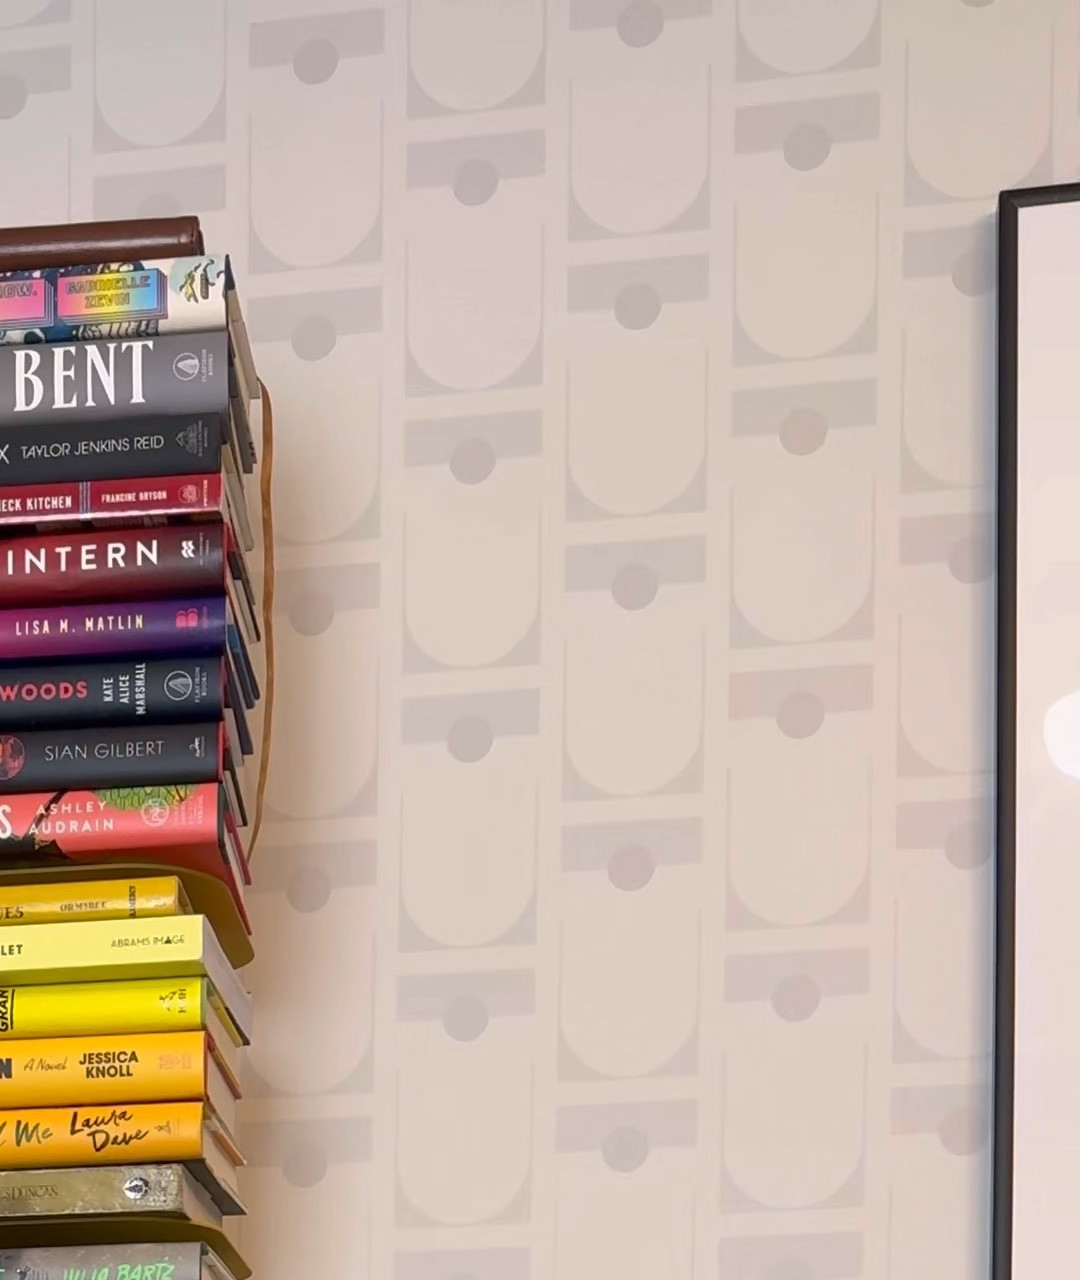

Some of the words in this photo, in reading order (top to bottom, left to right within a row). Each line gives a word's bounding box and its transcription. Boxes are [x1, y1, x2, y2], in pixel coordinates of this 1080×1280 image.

[13, 341, 153, 412] BENT
[21, 442, 70, 460] TAYLOR
[74, 438, 130, 456] JENKINS
[134, 435, 164, 450] REID
[26, 495, 72, 512] KITCHEN
[101, 492, 136, 504] FRANCINE
[139, 490, 167, 502] BRYSON
[7, 540, 158, 575] INTERN
[102, 676, 114, 702] KATE
[119, 674, 130, 704] ALICE
[136, 662, 146, 716] MARSHALL
[44, 744, 87, 762] SIAN
[94, 740, 165, 759] GILBERT
[36, 801, 108, 815] ASHLEY
[29, 818, 114, 835] AUDRAIN
[79, 1051, 139, 1065] JESSICA
[86, 1065, 133, 1079] KNOLL
